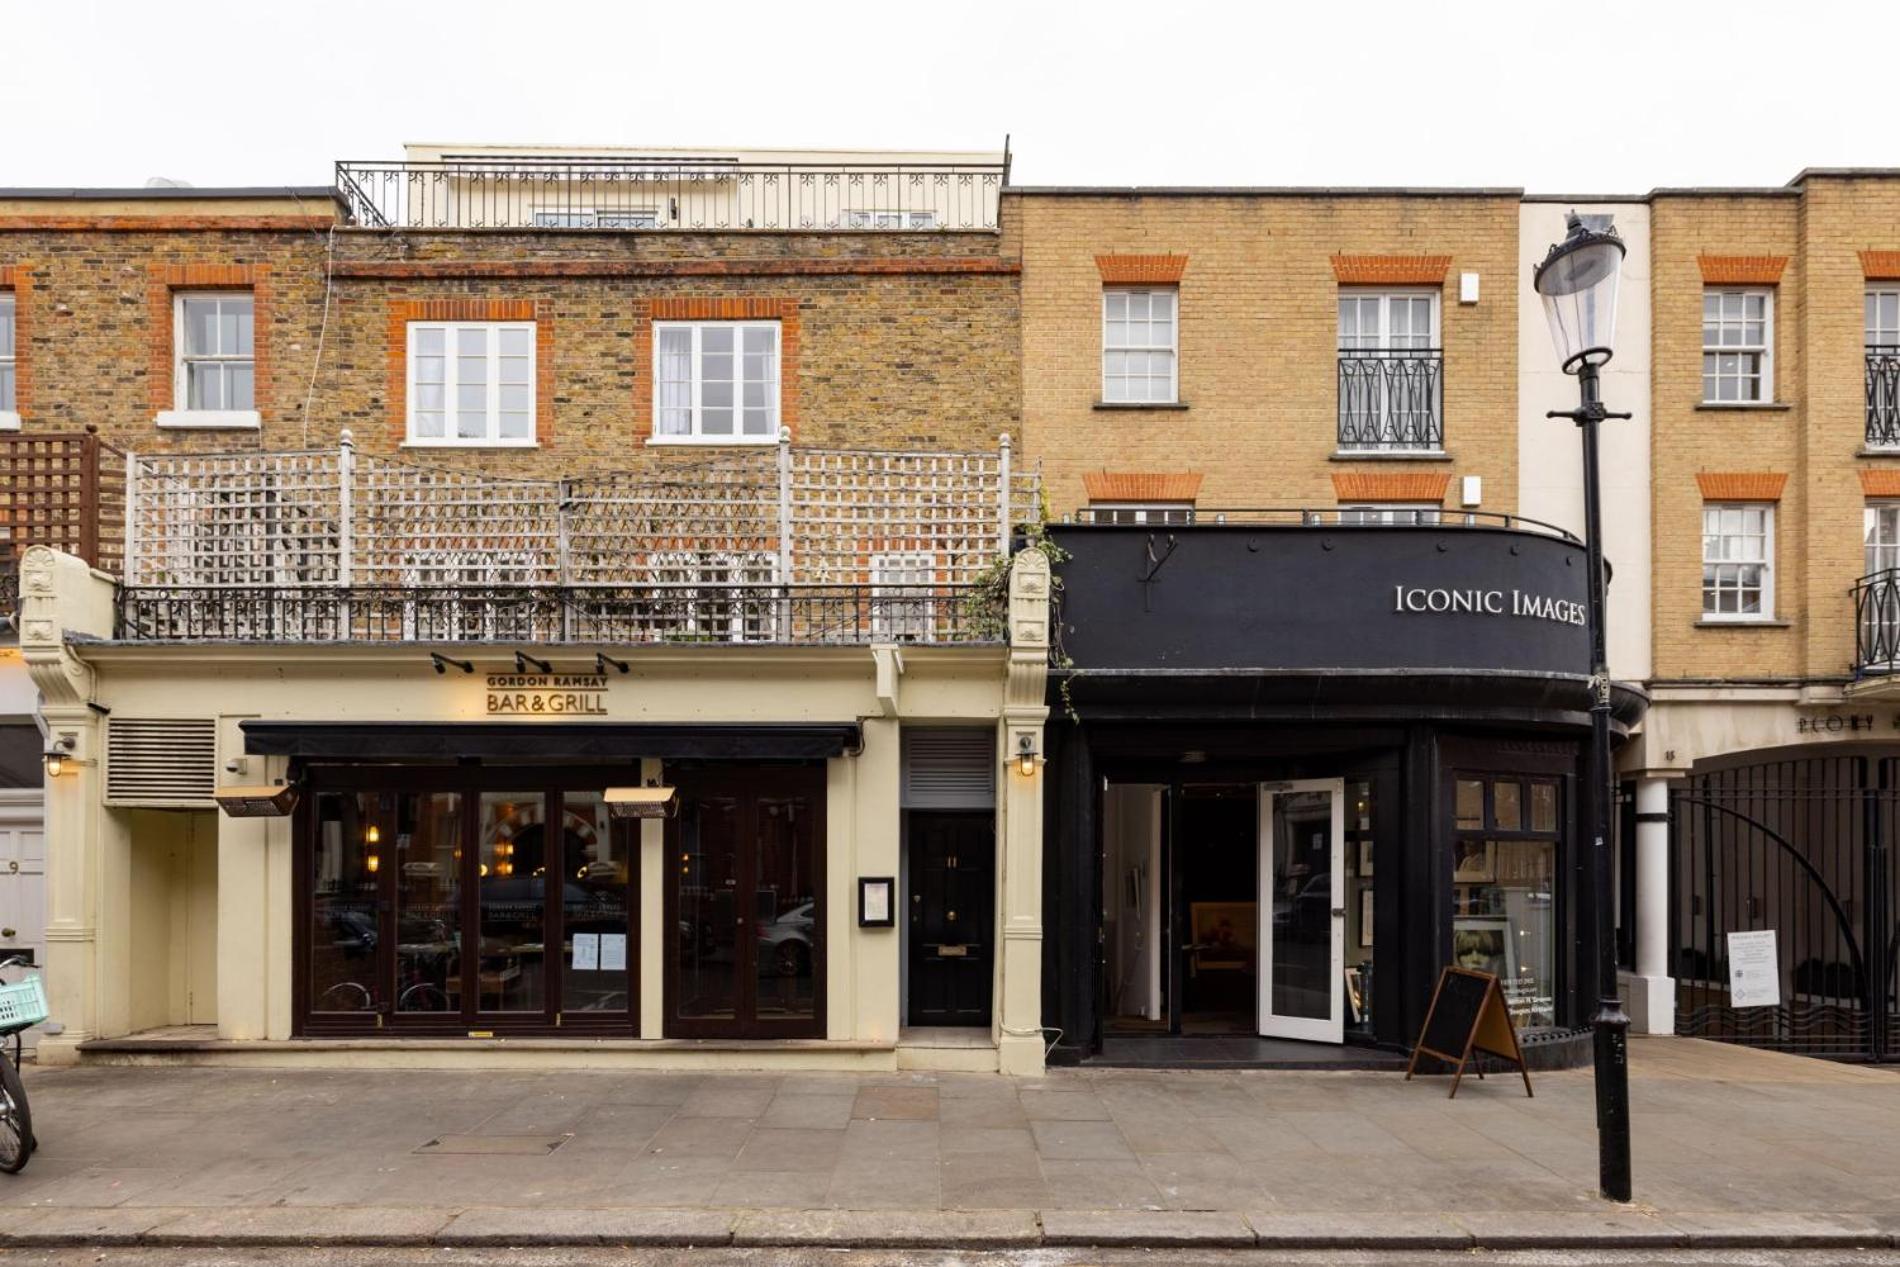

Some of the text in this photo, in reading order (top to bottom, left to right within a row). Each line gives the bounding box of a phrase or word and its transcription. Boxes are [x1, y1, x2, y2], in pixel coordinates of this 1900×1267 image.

[1395, 585, 1586, 626] ICONIC IMAGES
[487, 676, 608, 687] GORDON RAMSAY
[9, 861, 19, 875] 9
